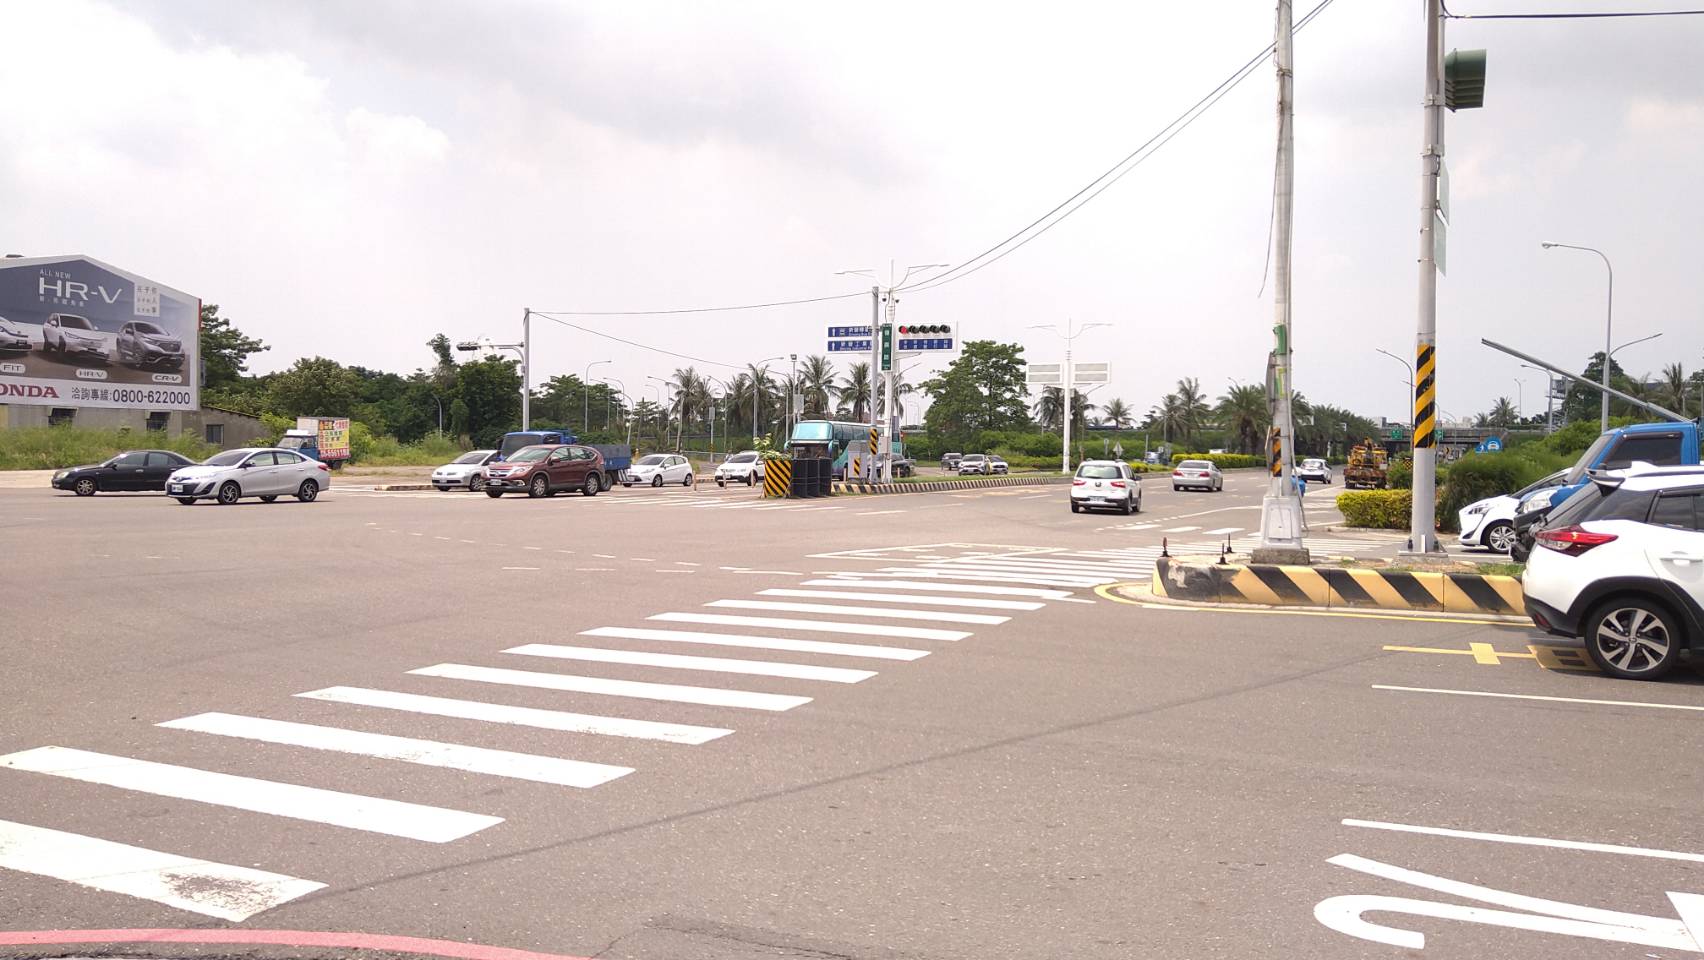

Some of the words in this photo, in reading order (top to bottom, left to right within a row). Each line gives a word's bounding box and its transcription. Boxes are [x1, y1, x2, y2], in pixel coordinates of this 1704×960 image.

[55, 271, 71, 279] NEW
[39, 277, 122, 304] HR-V
[3, 364, 21, 372] FIT
[154, 374, 179, 382] CR-V
